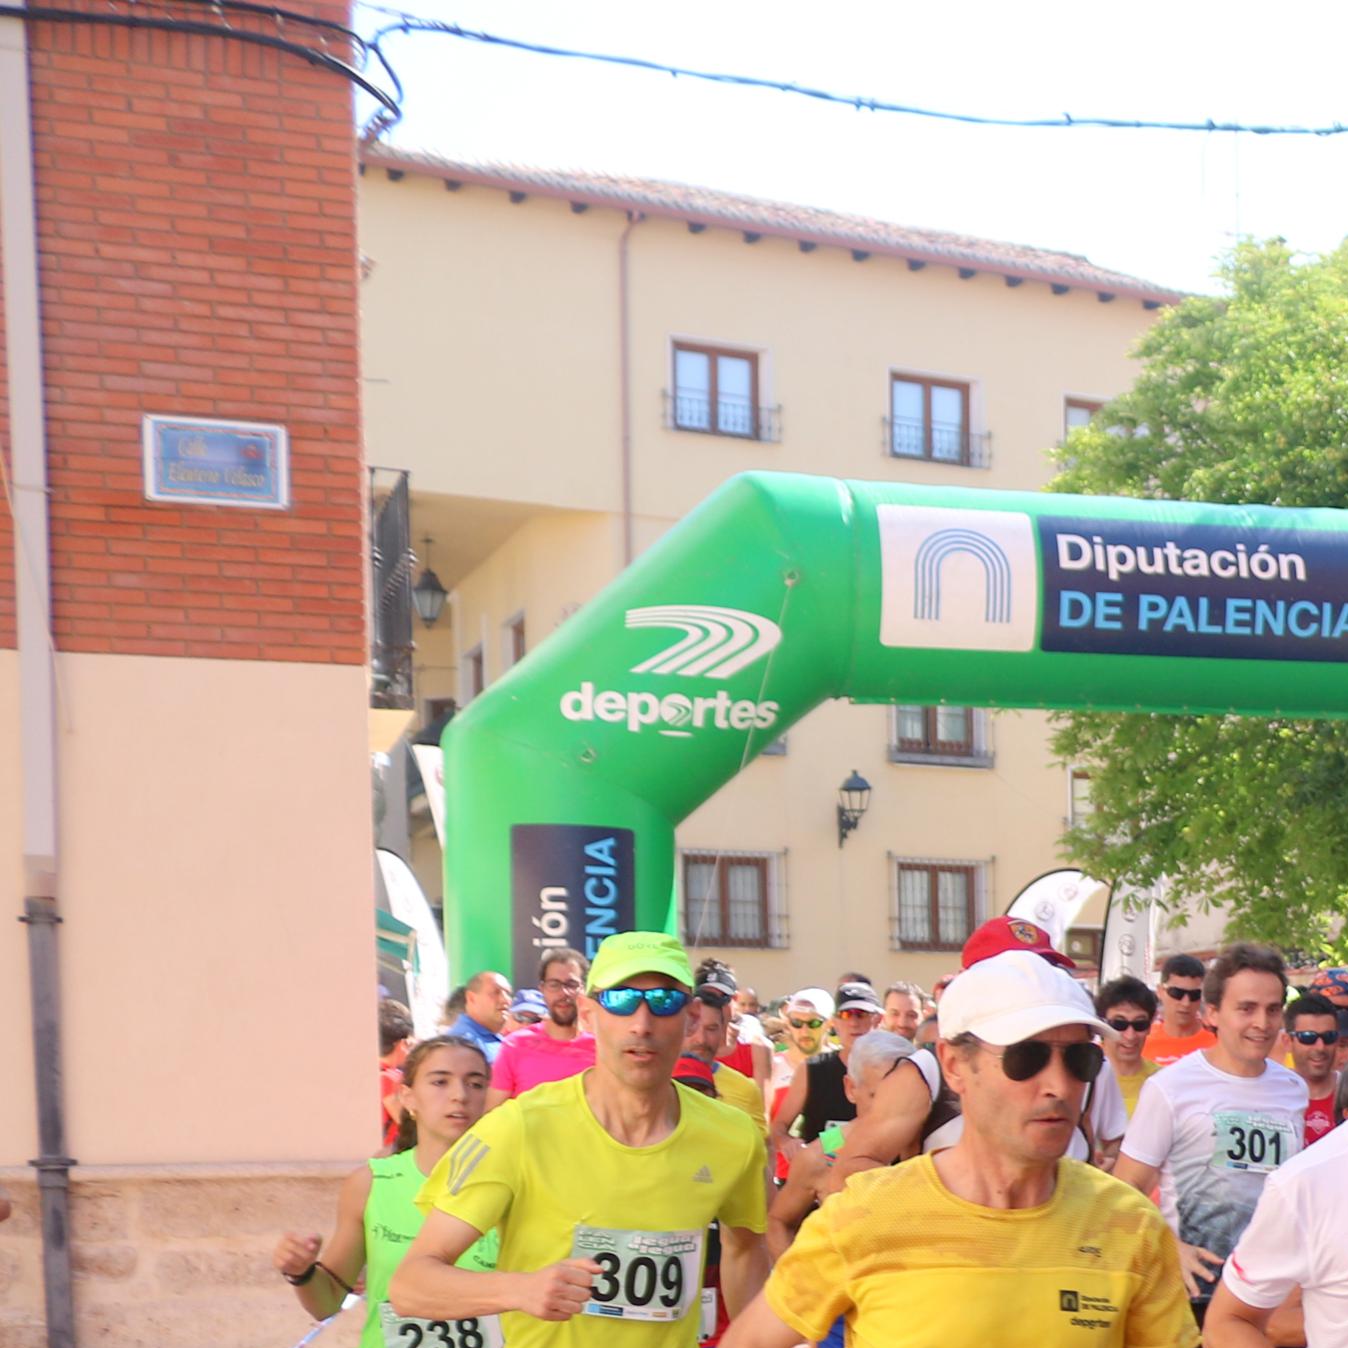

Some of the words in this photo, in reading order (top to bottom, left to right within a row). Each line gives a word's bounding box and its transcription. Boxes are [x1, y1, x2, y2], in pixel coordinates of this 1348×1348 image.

[1055, 533, 1307, 581] Diputación
[1058, 590, 1124, 630] DE
[559, 681, 780, 735] deportes
[1226, 1126, 1281, 1166] 301
[590, 1252, 683, 1308] 309
